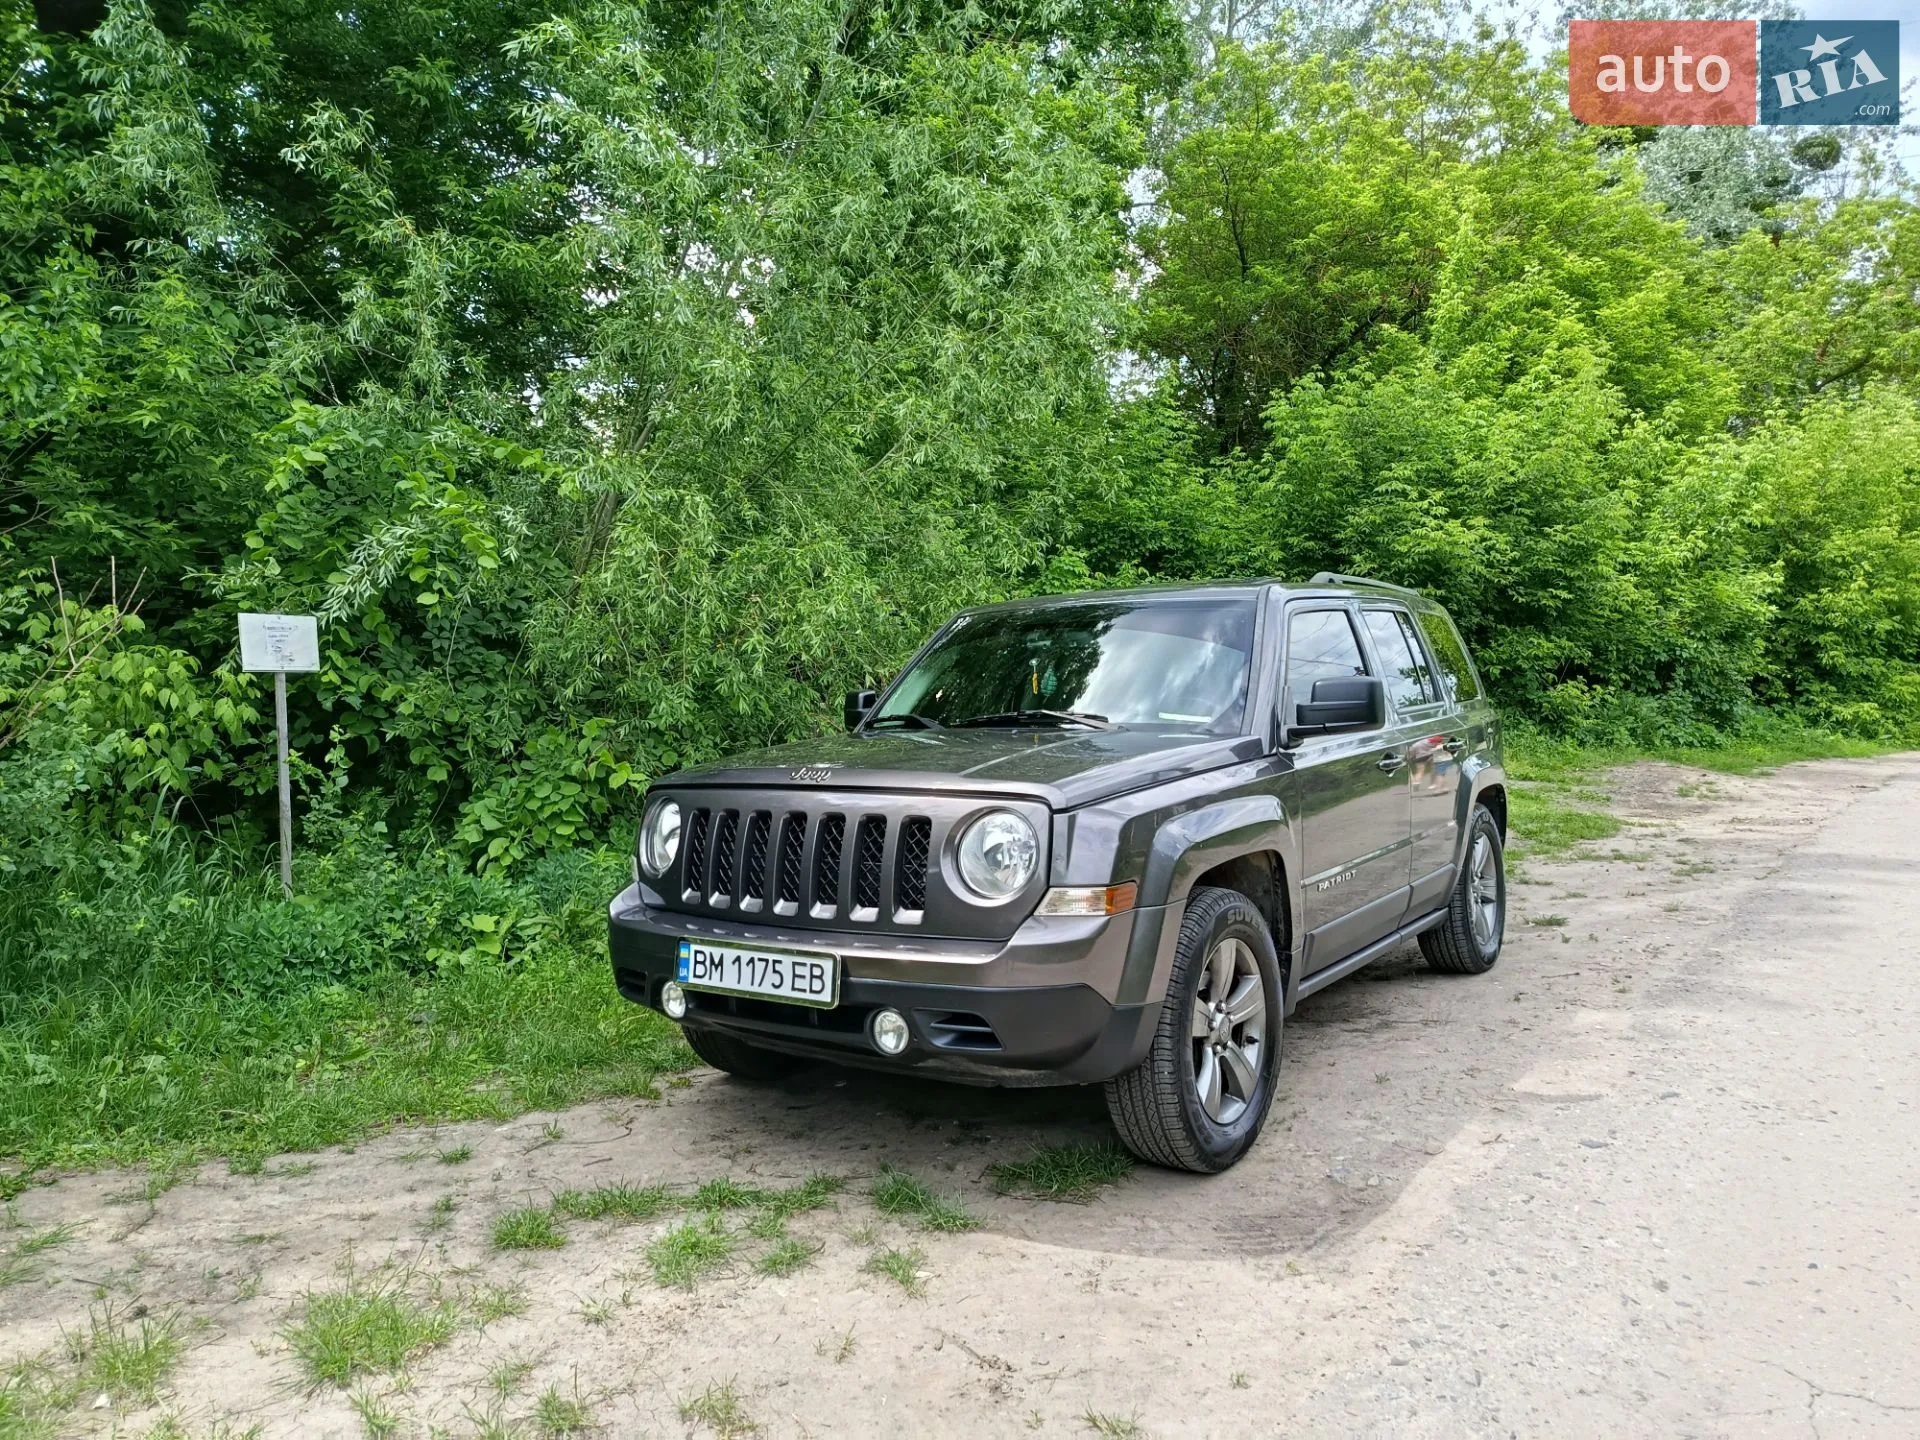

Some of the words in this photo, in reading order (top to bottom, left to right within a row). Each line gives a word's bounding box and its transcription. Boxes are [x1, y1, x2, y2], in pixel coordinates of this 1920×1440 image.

[790, 767, 831, 783] Jeep
[1317, 869, 1357, 891] PATRIOT
[679, 967, 688, 977] UA
[693, 949, 724, 983] BM
[732, 955, 784, 990] 1175
[791, 961, 826, 994] EB
